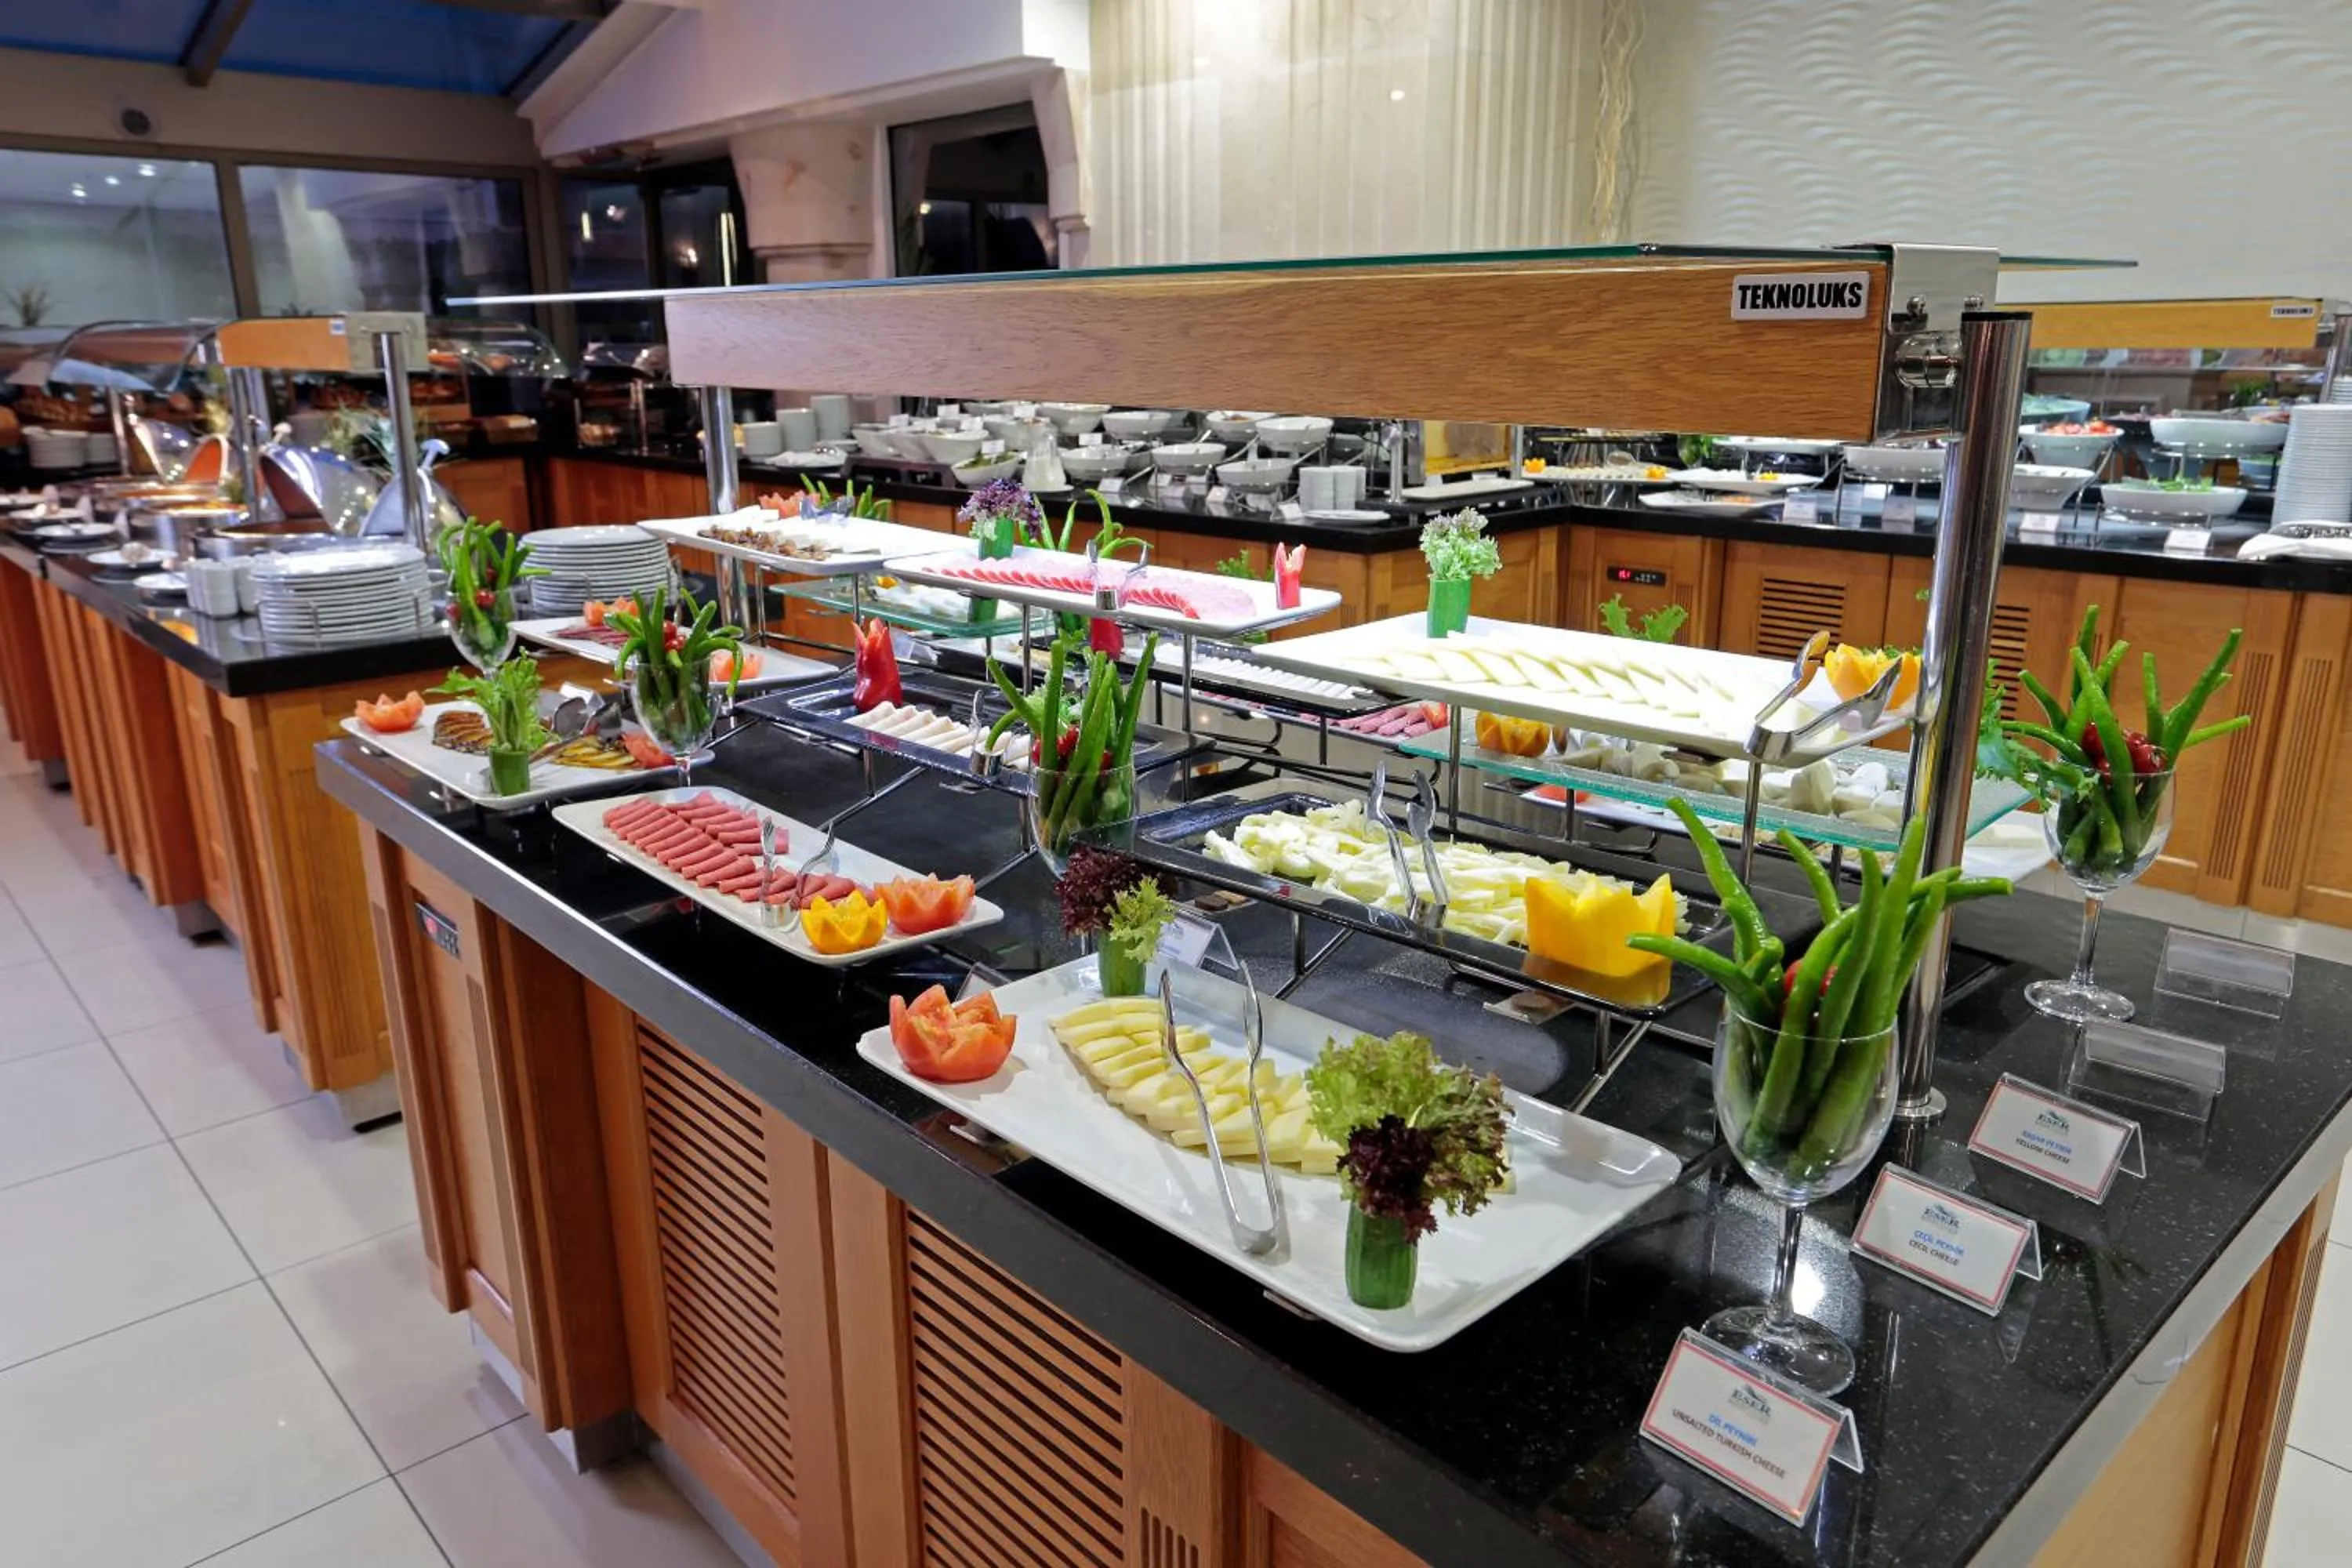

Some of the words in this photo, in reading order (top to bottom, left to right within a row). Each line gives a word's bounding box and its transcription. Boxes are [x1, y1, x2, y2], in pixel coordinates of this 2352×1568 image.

[1738, 282, 1863, 310] TEKNOLUKS
[2044, 1149, 2070, 1164] CHEESE
[1929, 1249, 1958, 1265] CHEESE
[1672, 1409, 1715, 1437] UNSALTED
[1715, 1433, 1751, 1460] TURKISH
[1752, 1454, 1787, 1479] CHEESE
